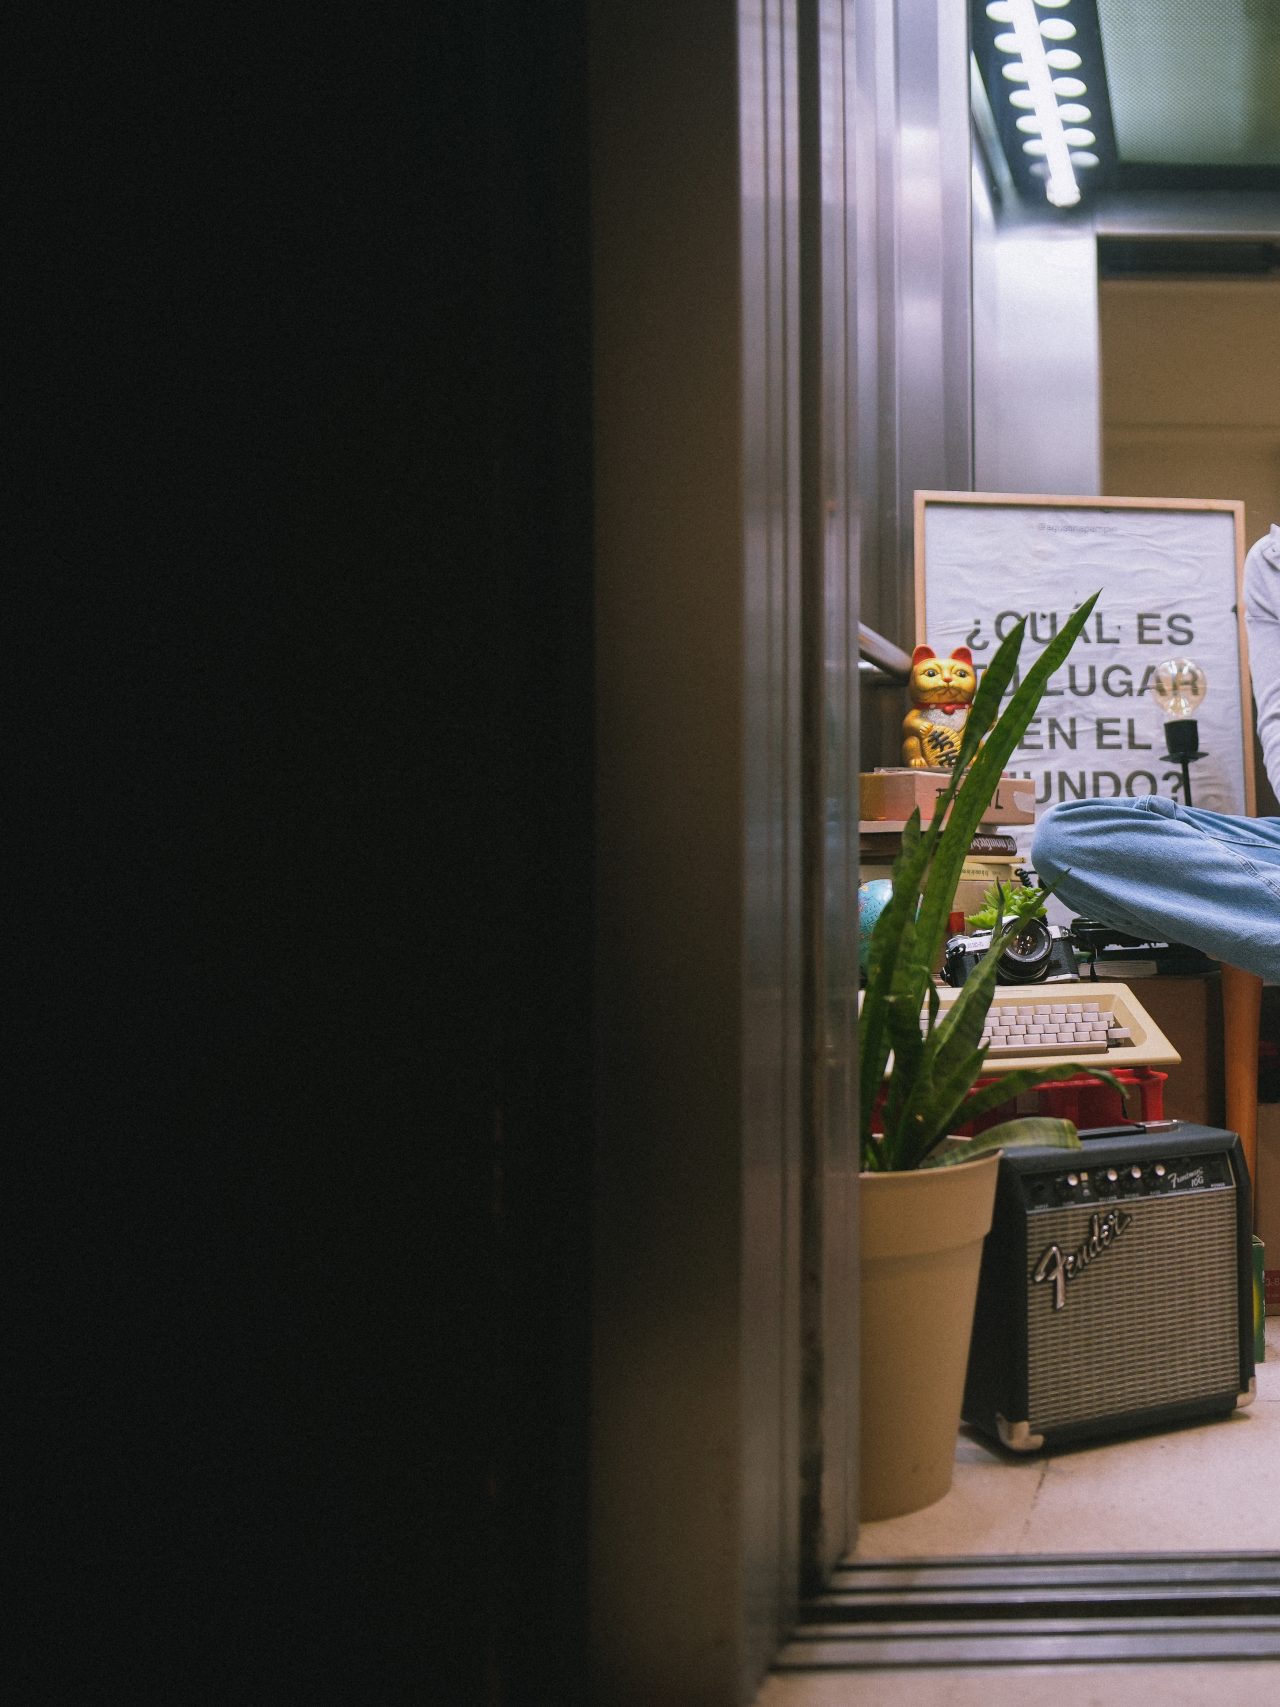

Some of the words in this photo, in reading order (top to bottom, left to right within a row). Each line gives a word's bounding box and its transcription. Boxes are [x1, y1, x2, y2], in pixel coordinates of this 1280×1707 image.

[1137, 612, 1195, 646] ES
[1017, 716, 1078, 751] EN
[1095, 717, 1153, 750] EL
[1008, 770, 1185, 804] UNDO?
[1033, 1208, 1134, 1311] Fender
